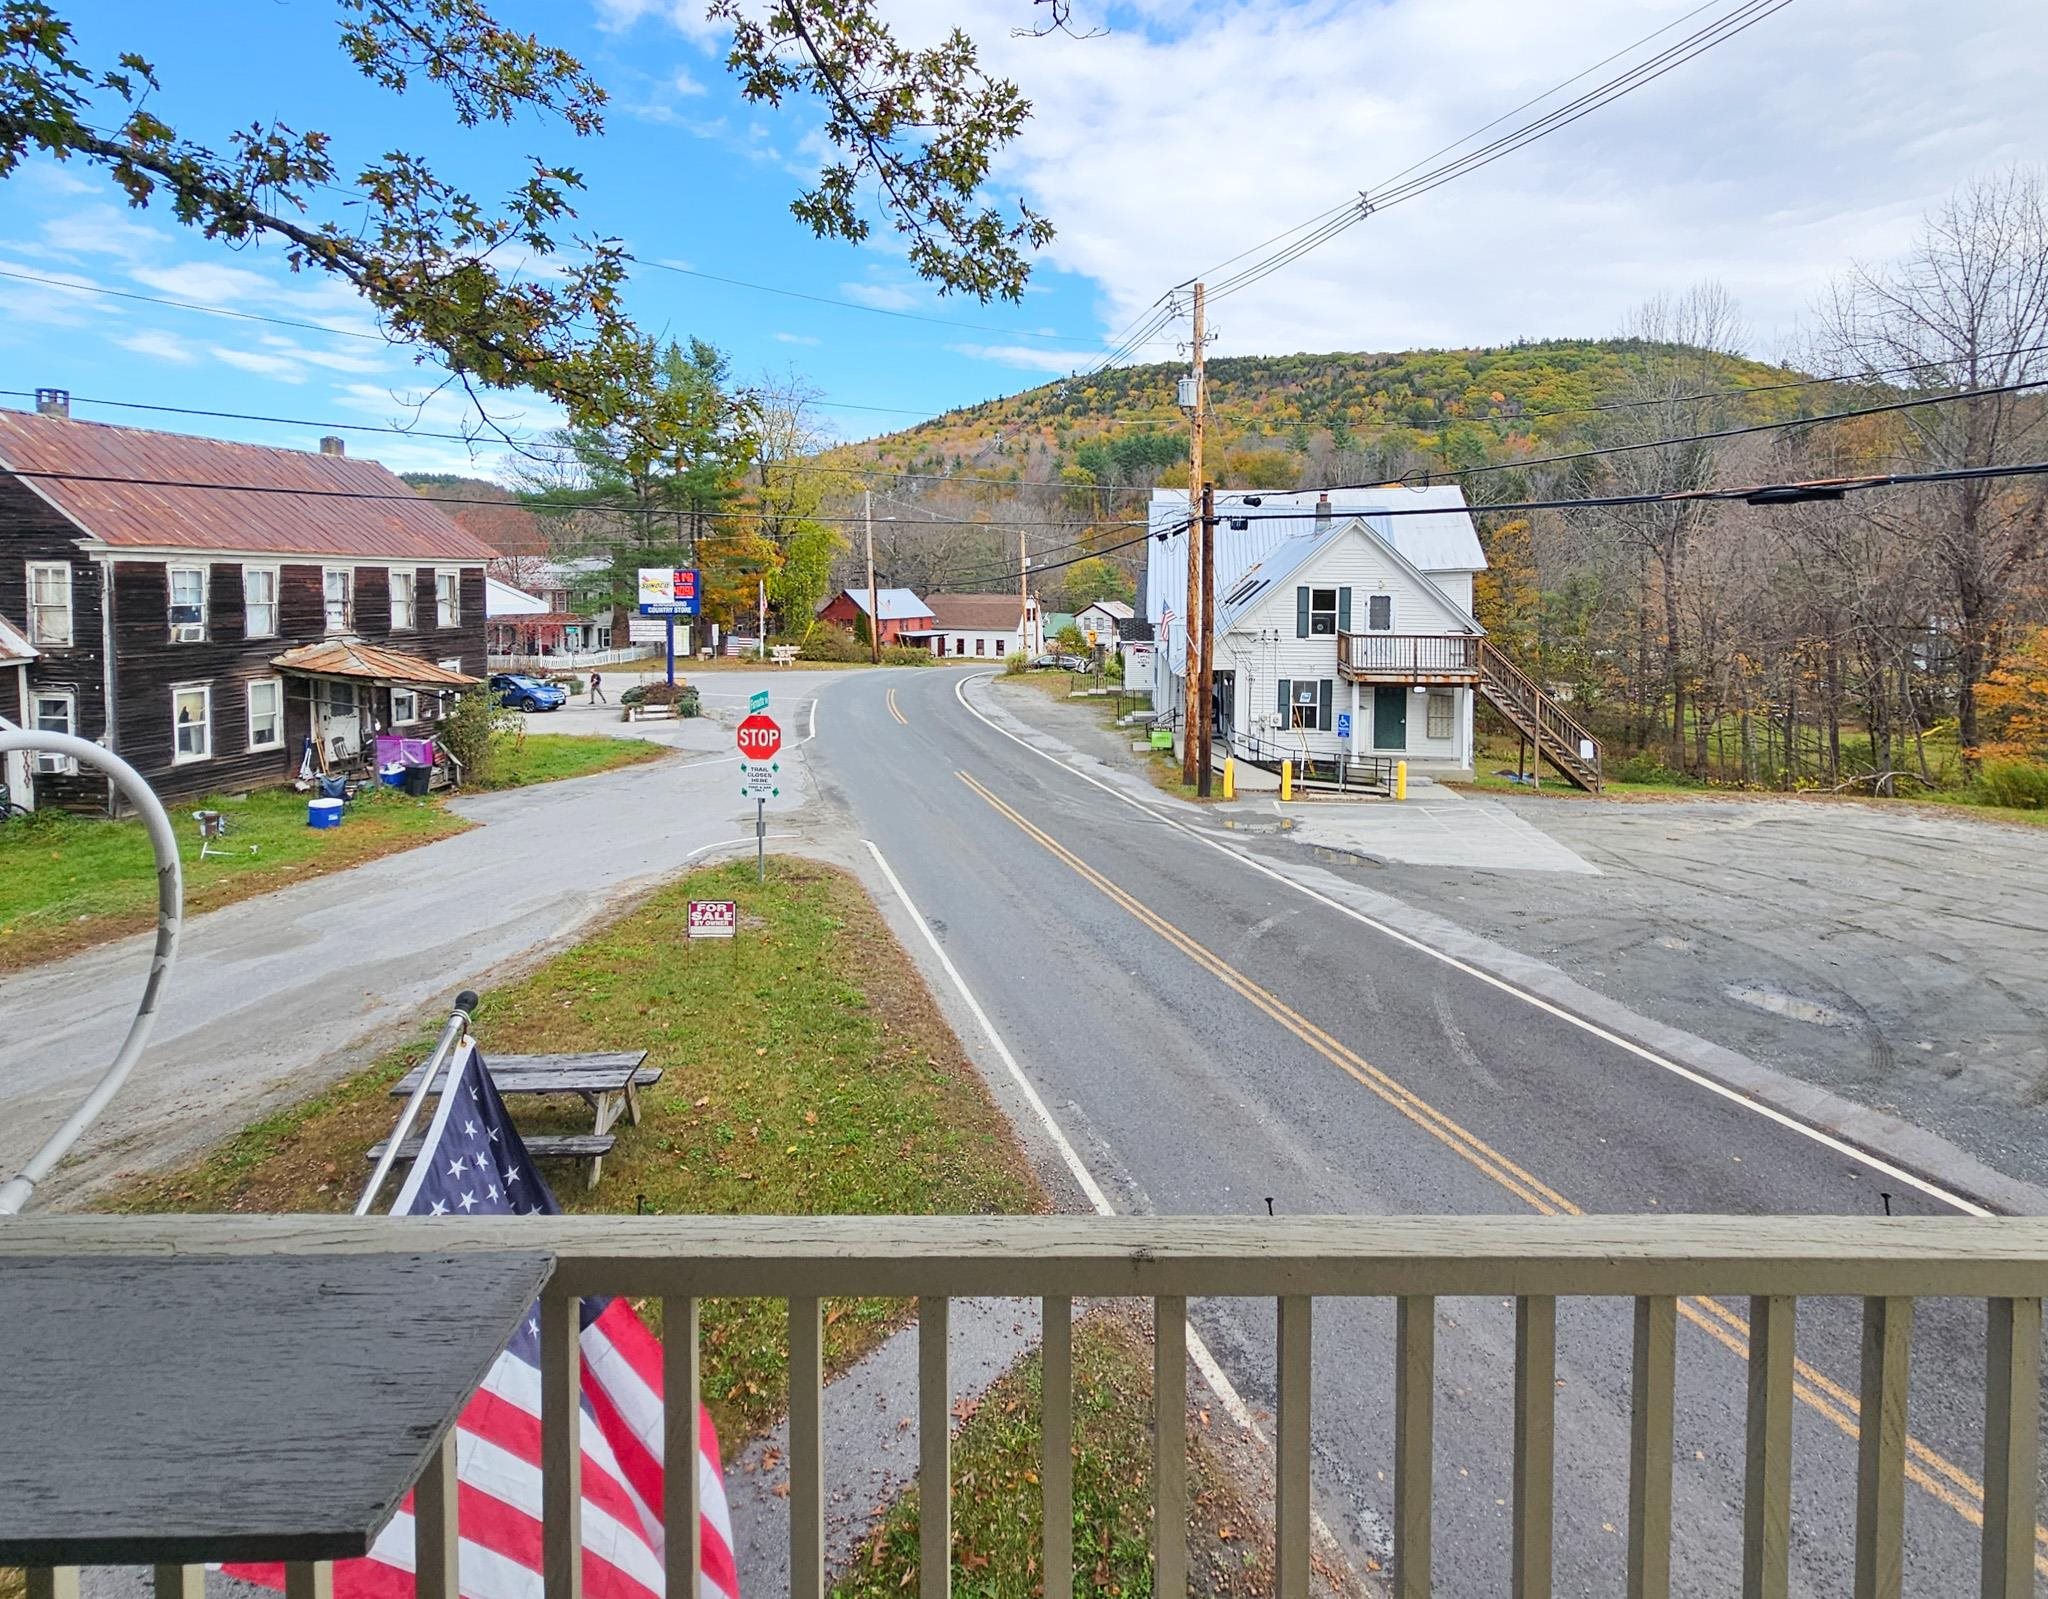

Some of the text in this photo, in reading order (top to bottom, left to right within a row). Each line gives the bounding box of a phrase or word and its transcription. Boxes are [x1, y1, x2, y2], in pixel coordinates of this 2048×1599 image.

[648, 606, 692, 614] COUNTRY STORE
[739, 728, 779, 747] STOP
[697, 904, 727, 912] FOR
[691, 912, 732, 920] SALE
